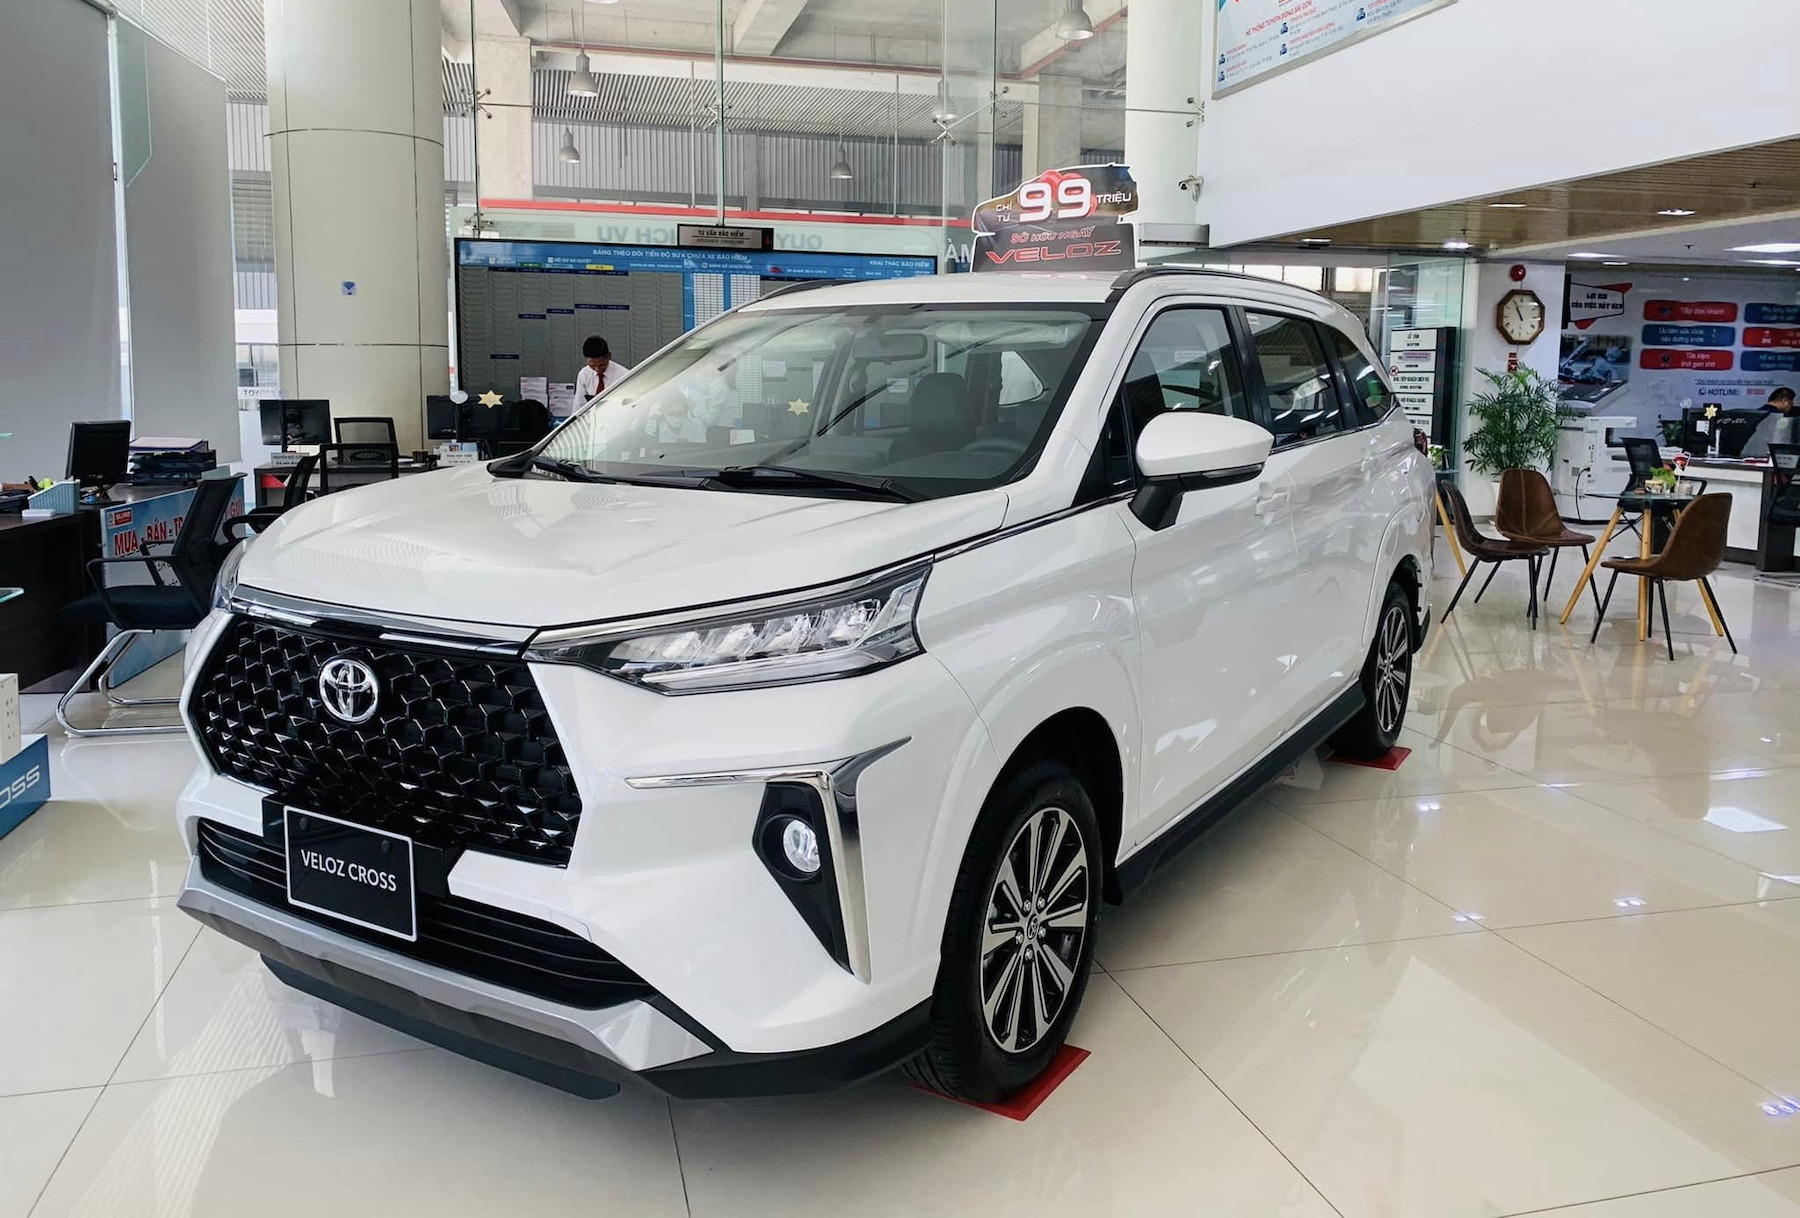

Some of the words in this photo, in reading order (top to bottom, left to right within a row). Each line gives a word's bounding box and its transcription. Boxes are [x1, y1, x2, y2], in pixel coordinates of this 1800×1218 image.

[1019, 178, 1092, 223] 99
[1096, 191, 1132, 205] TRIỆU
[985, 240, 1122, 265] VELOZ
[1708, 388, 1739, 396] HOTLINE:
[114, 529, 139, 557] MUA
[146, 517, 168, 541] BÁN
[301, 848, 346, 878] VELOZ
[348, 862, 397, 892] CROSS
